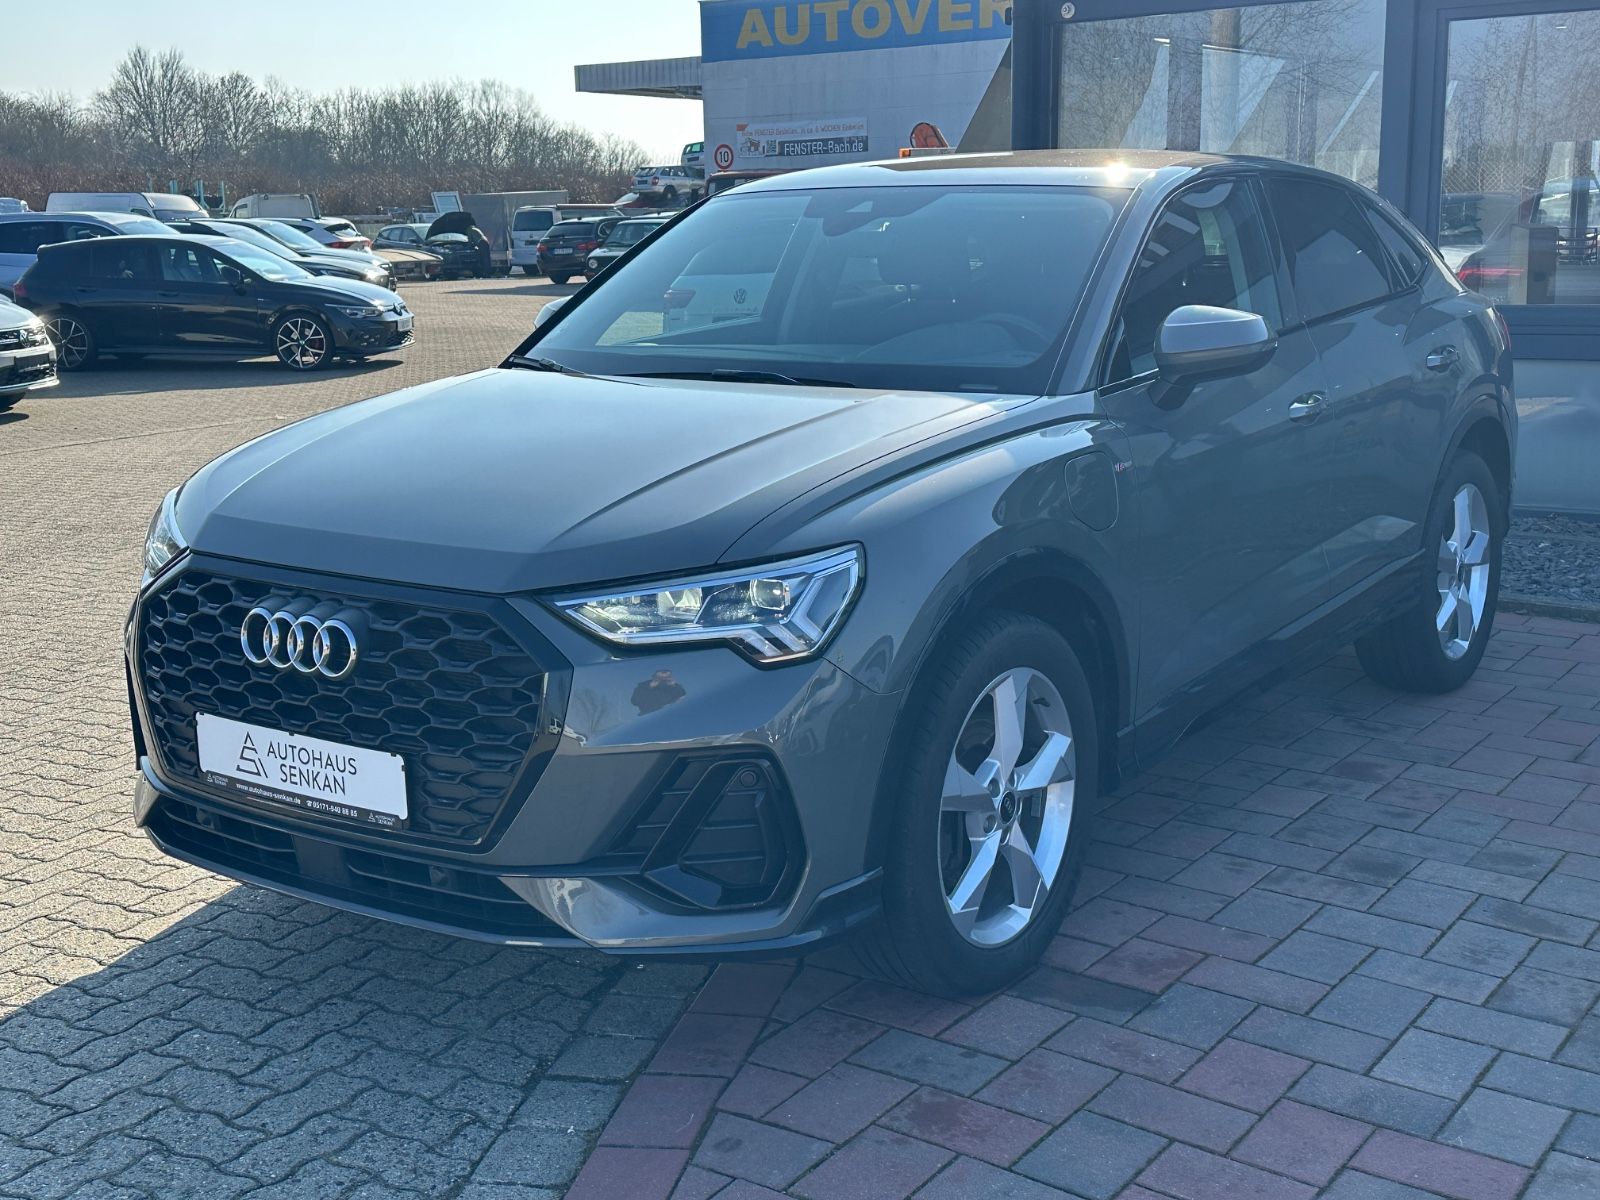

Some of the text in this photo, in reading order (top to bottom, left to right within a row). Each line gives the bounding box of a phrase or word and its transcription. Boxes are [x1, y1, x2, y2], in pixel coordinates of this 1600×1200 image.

[719, 150, 729, 163] 10
[784, 140, 863, 156] FENSTER-Bach.de
[267, 741, 357, 775] AUTOHAUS
[280, 763, 346, 795] SENKAN
